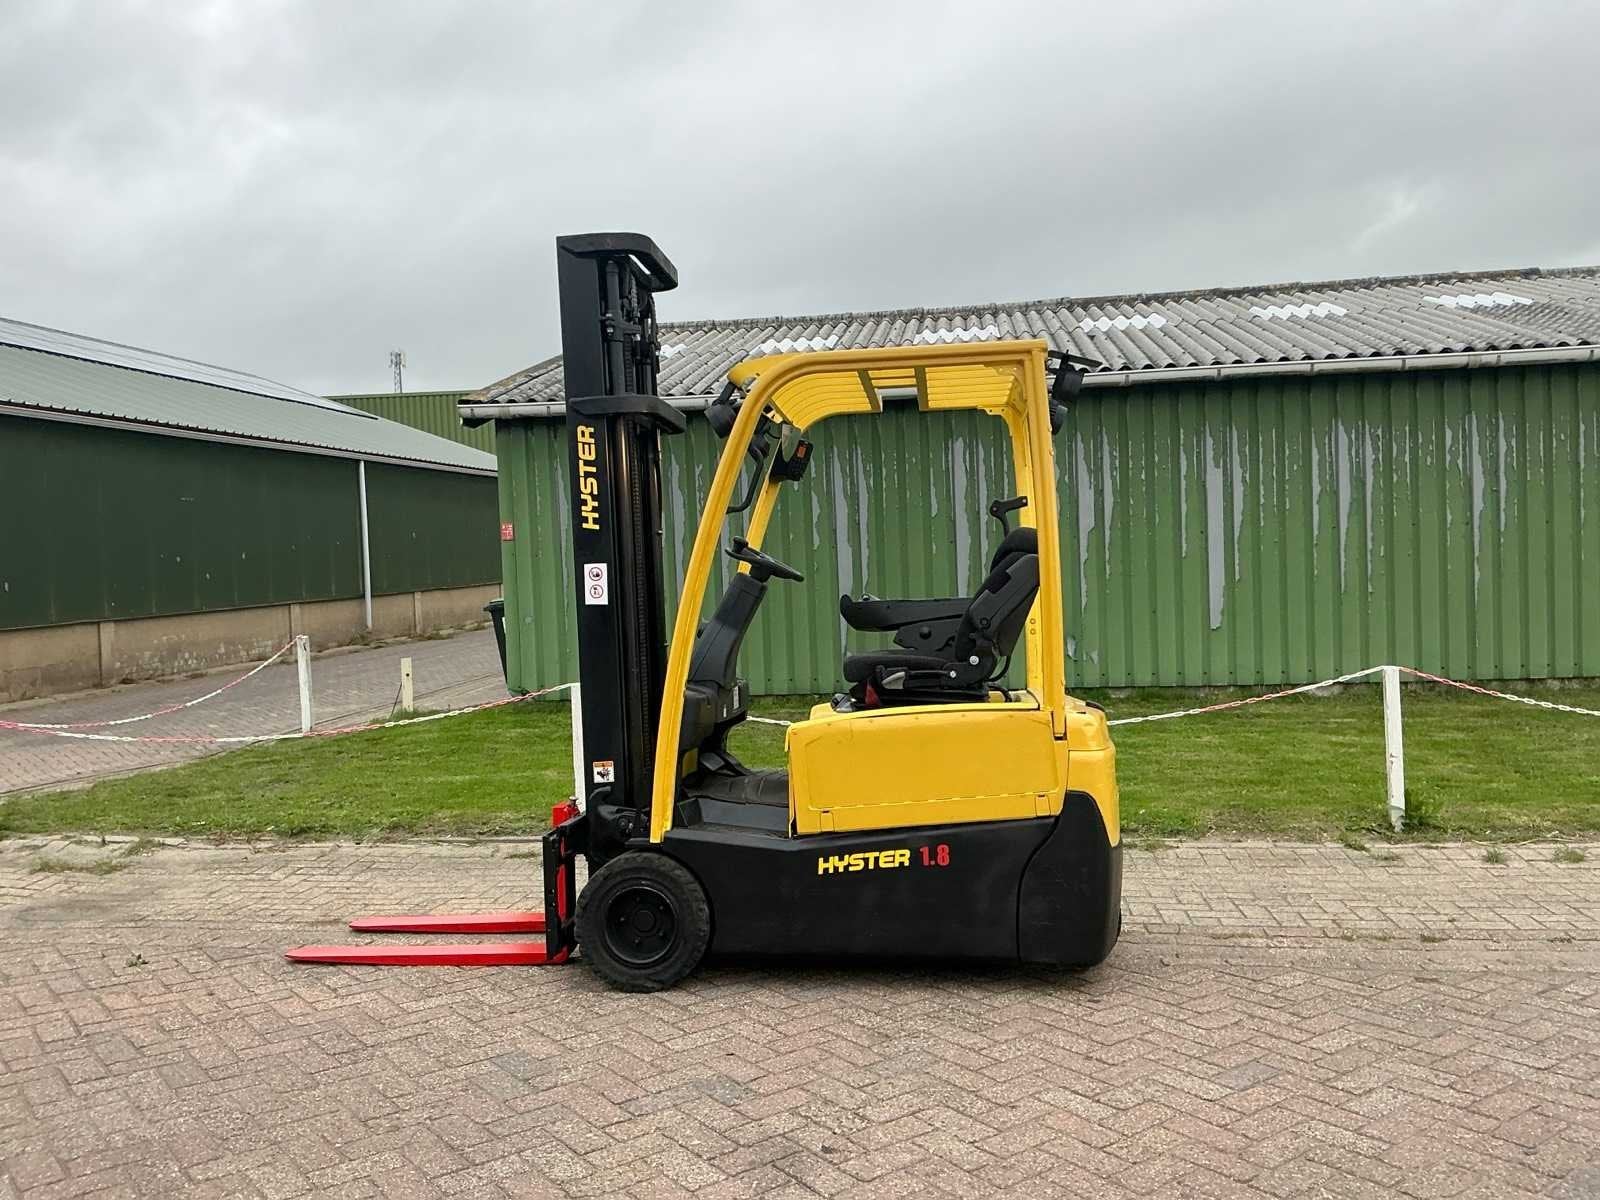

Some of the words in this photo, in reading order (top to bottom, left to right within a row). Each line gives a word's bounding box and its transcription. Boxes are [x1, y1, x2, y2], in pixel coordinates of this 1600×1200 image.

[576, 425, 600, 530] HYSTER
[817, 849, 911, 875] HYSTER
[919, 844, 950, 866] 1.8
